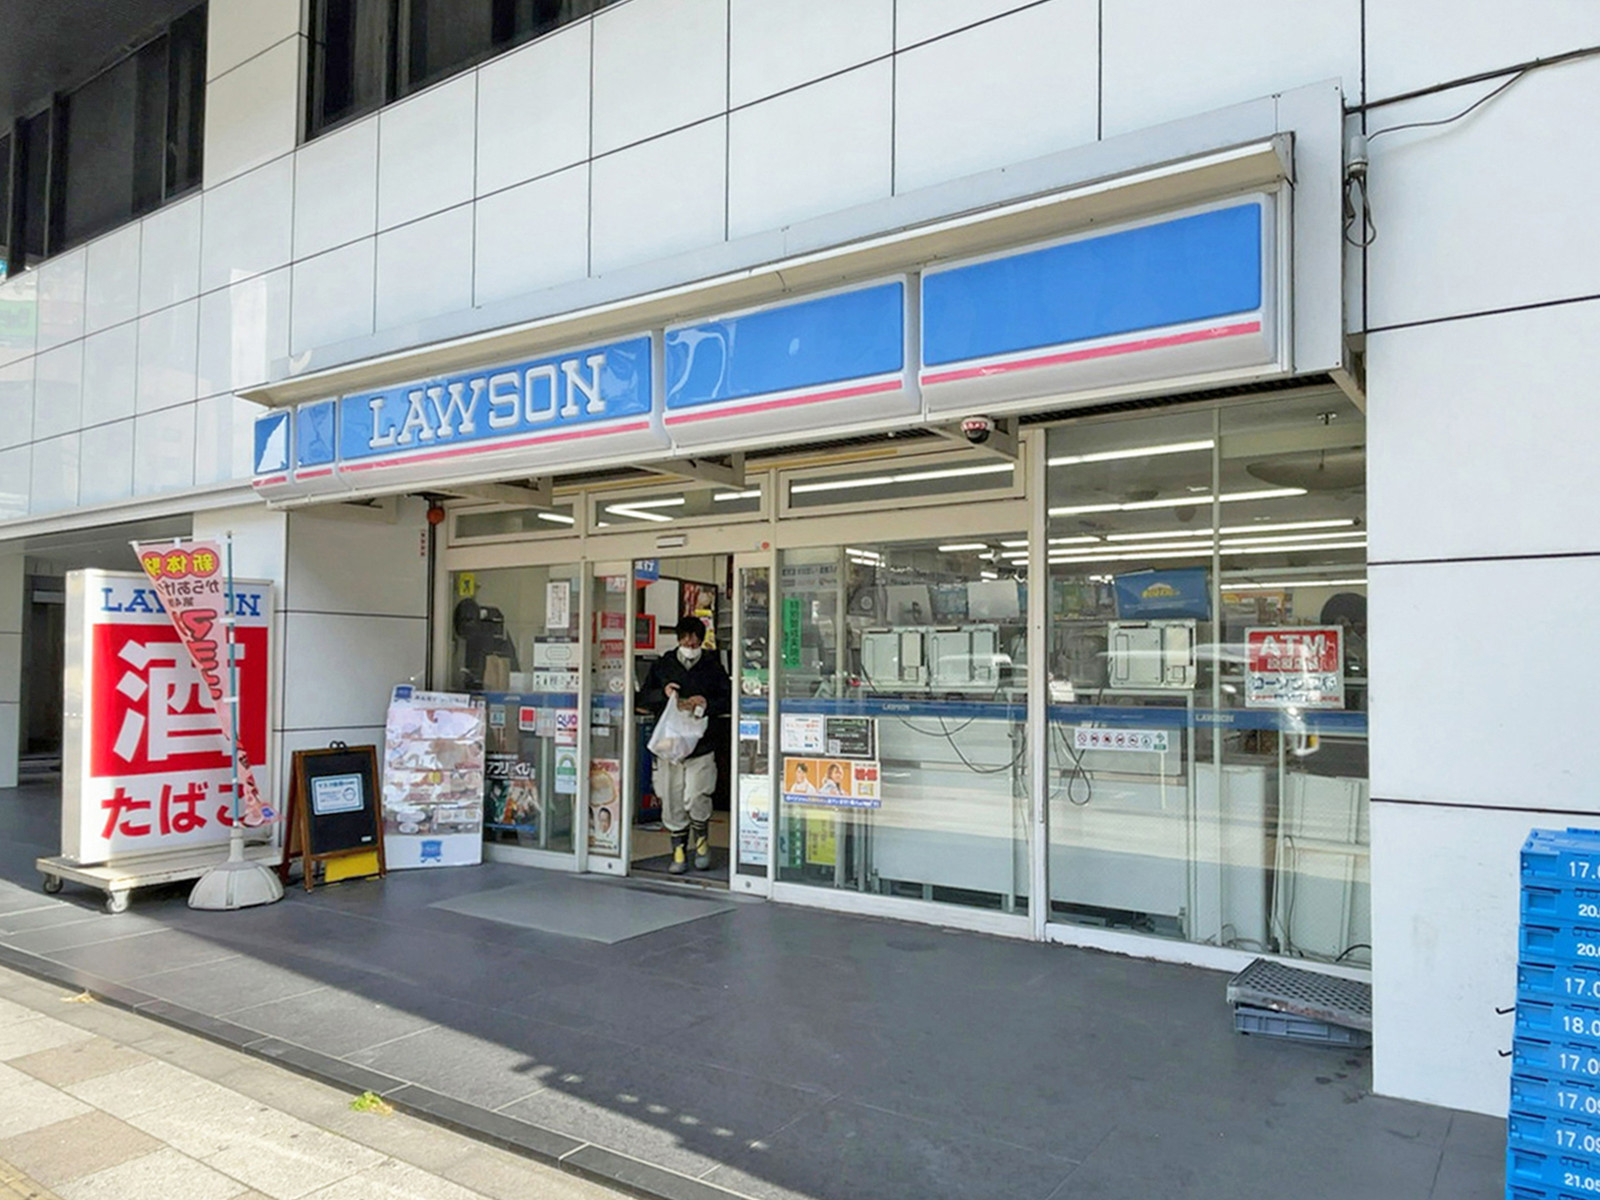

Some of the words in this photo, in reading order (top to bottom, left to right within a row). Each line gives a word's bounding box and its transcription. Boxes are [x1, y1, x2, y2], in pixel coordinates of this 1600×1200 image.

[368, 354, 606, 448] LAWSON
[100, 586, 261, 617] LAN
[1259, 634, 1327, 657] ATM
[112, 638, 246, 763] 酒
[556, 713, 579, 728] QUO
[100, 780, 247, 840] たばこ
[1569, 861, 1600, 881] 17.
[1578, 903, 1600, 918] 20.
[1576, 942, 1600, 957] 20.
[1563, 1015, 1600, 1037] 18.0
[1560, 1053, 1600, 1075] 17.0
